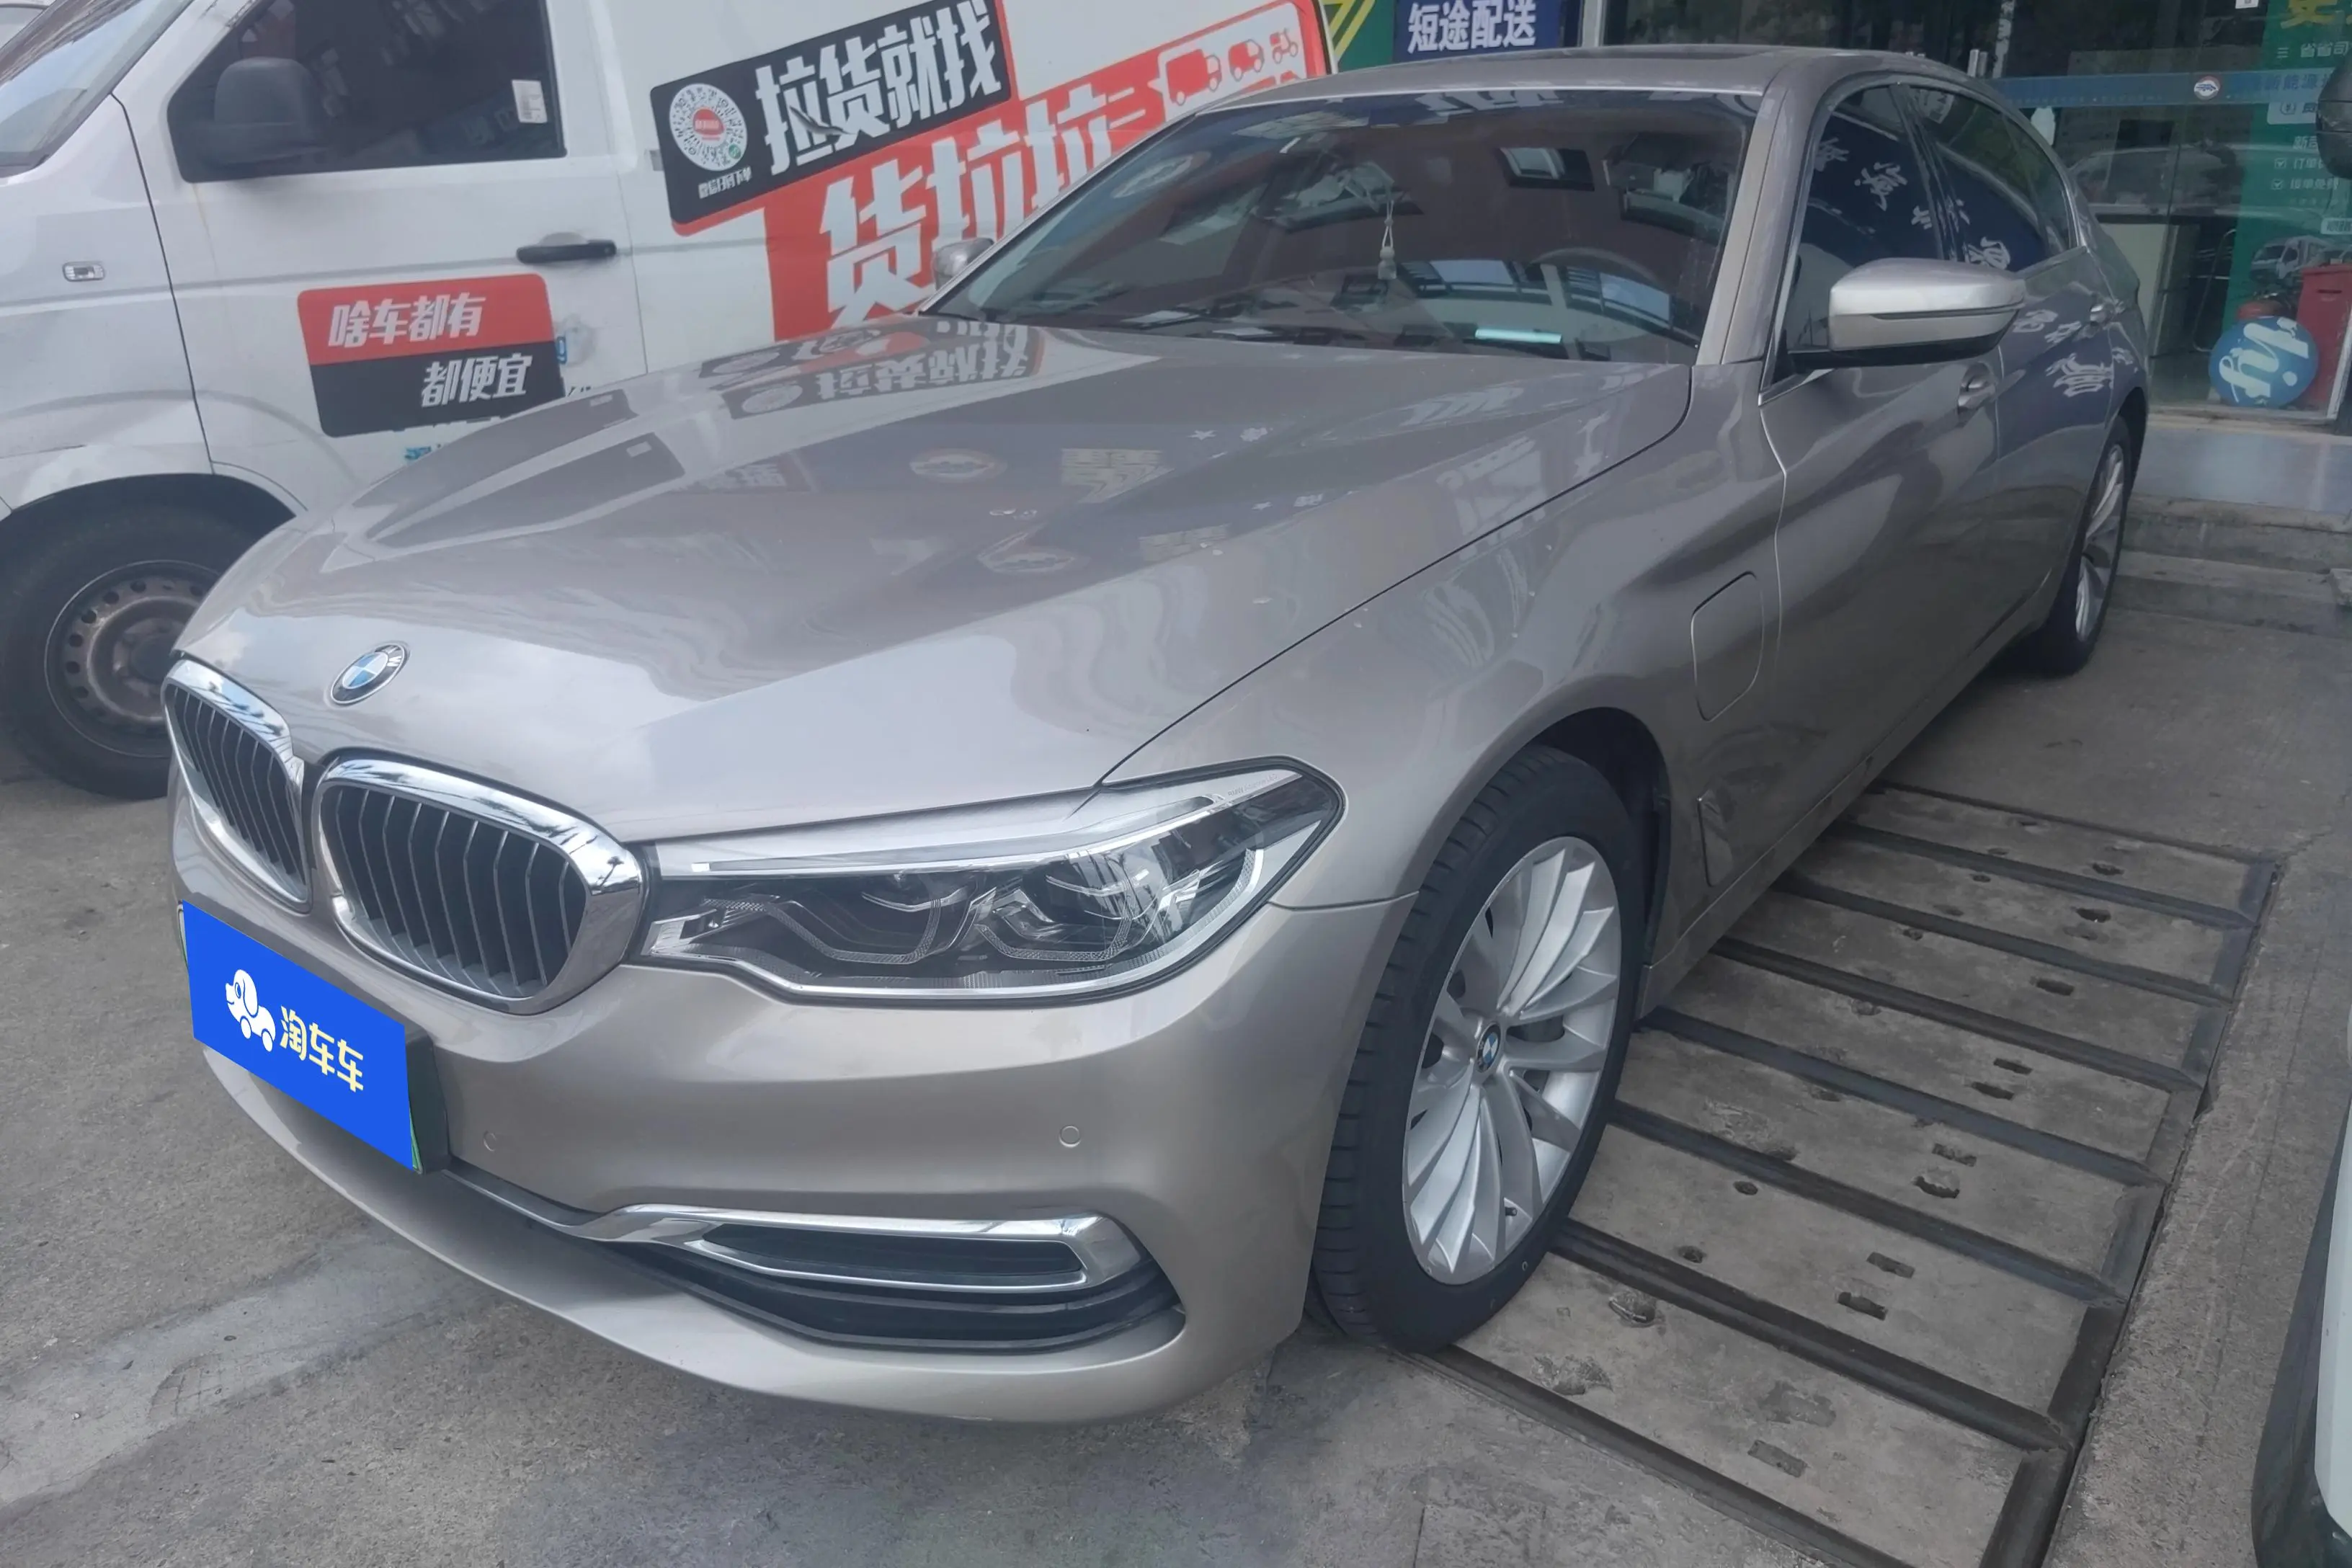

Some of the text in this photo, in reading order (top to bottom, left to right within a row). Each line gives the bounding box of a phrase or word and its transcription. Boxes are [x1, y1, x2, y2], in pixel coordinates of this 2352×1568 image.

[1407, 0, 1537, 54] 短途配送
[755, 0, 1001, 176] 拉货就找
[820, 84, 1113, 330] 货拉拉
[328, 292, 486, 348] 啥车都有
[421, 352, 533, 408] 都便宜
